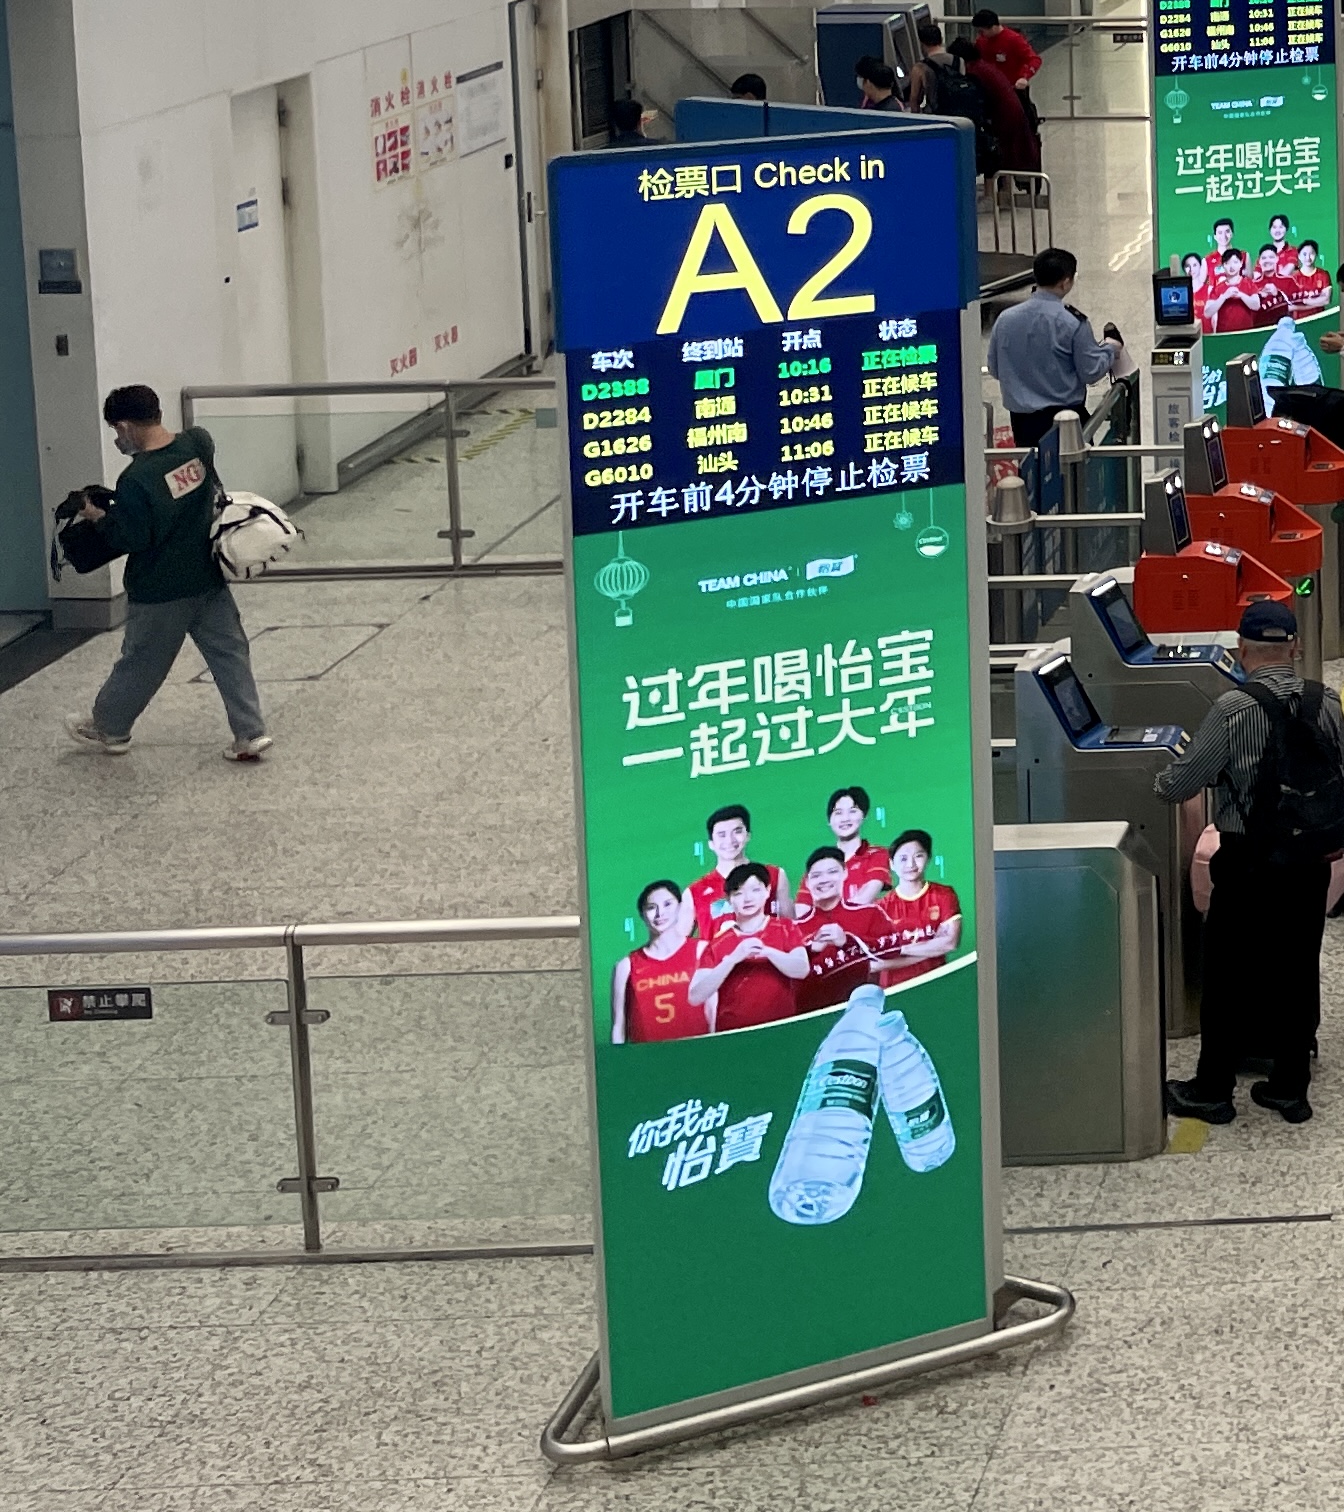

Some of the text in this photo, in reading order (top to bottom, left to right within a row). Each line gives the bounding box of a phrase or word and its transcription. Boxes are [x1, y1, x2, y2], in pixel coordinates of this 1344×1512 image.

[1171, 45, 1320, 73] 开车前4分钟停止检票
[370, 86, 411, 118] 消火栓
[639, 154, 885, 202] 检票口 Check in
[1175, 165, 1321, 204] 一起过大年
[1176, 136, 1321, 177] 过年喝怡宝
[656, 193, 876, 335] A2
[582, 343, 938, 402] D2388 厦门 10:16 正在检票
[591, 318, 917, 371] 车次 终到站 开点 状态
[582, 371, 938, 430] D2284 南通 10:31 正在候车
[583, 398, 939, 459] G1626 福州南 10:46 正在候车
[584, 424, 939, 487] G6010 汕头 11:06 正在候车
[610, 451, 931, 524] 开车前4分钟停止检票
[698, 568, 789, 593] TEAM CHINA
[622, 629, 935, 731] 过年喝怡宝
[622, 685, 935, 779] 一起过大年
[635, 970, 689, 992] CHINA
[654, 991, 676, 1024] 5
[628, 1098, 730, 1158] 你我的
